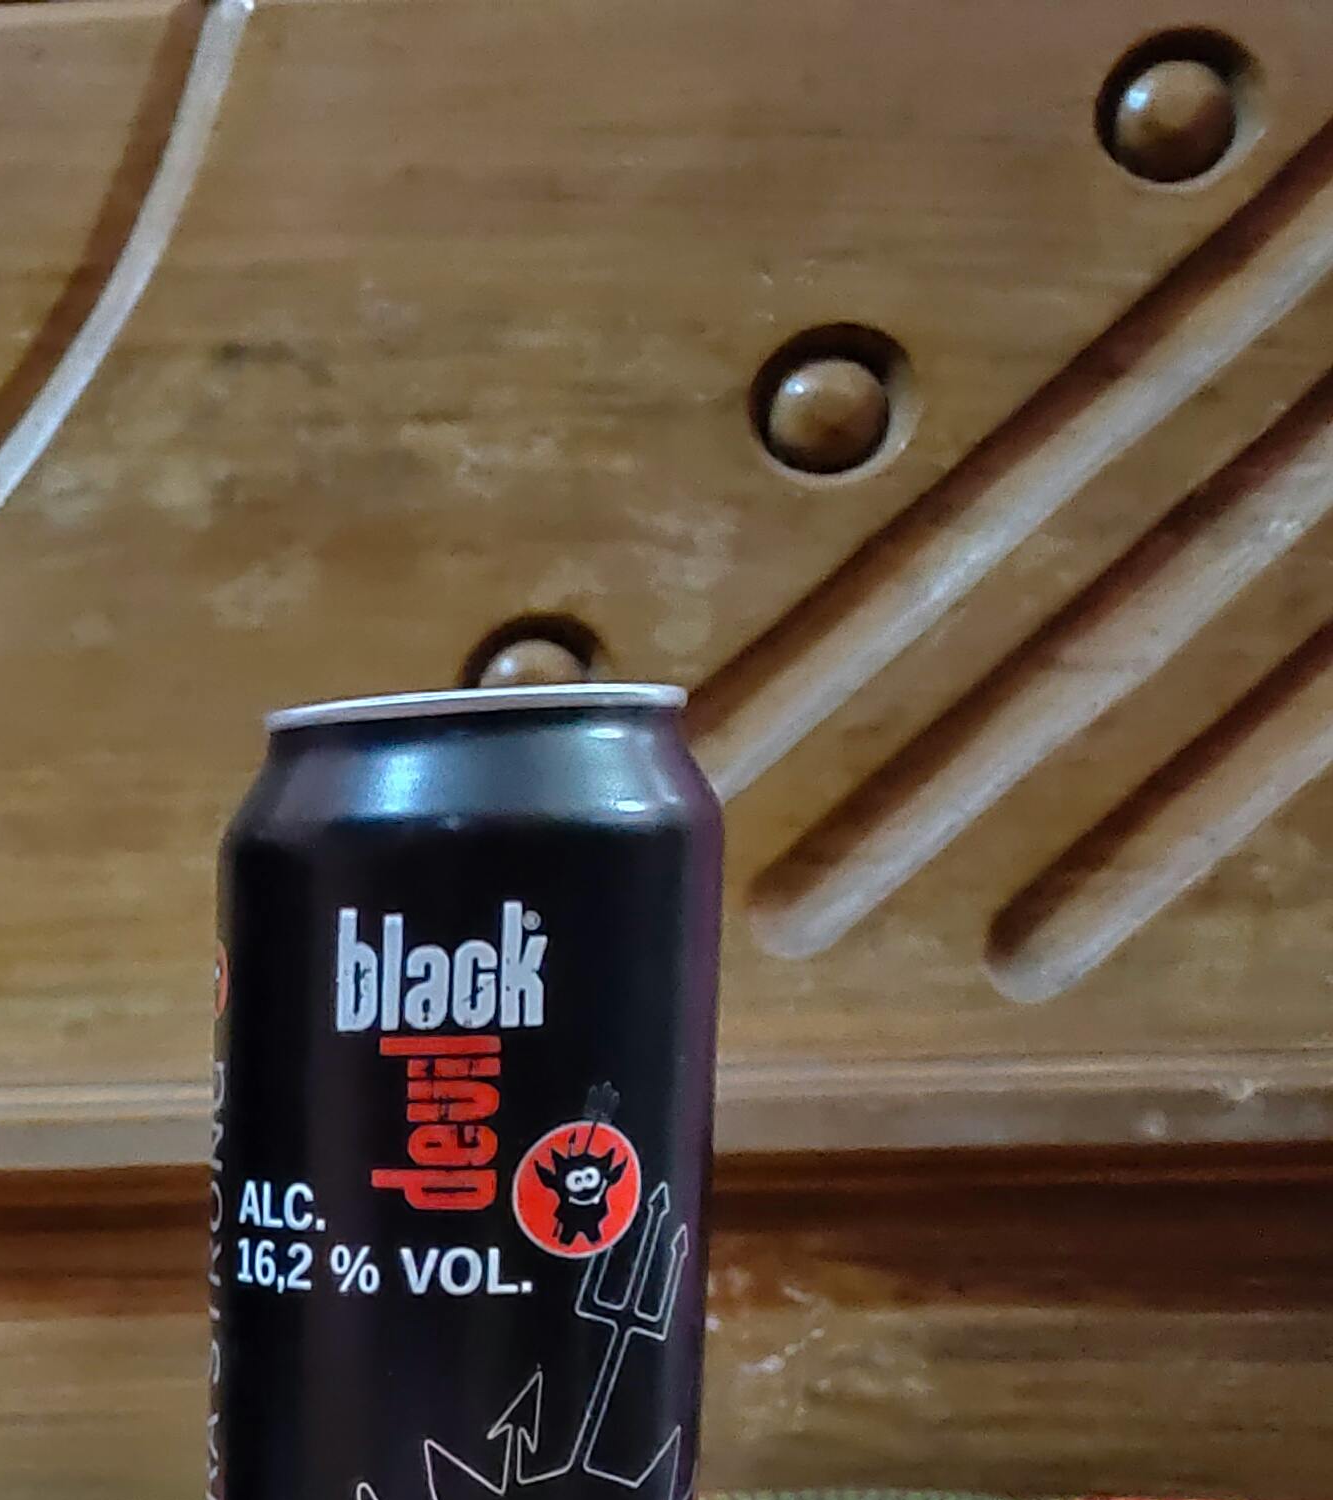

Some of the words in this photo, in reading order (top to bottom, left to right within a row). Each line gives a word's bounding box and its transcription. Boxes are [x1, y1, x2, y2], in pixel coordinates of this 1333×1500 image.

[371, 1035, 502, 1210] devil
[238, 1179, 326, 1232] ALC.
[236, 1237, 314, 1294] 16,2
[329, 1244, 380, 1294] %
[399, 1246, 534, 1295] VOL.
